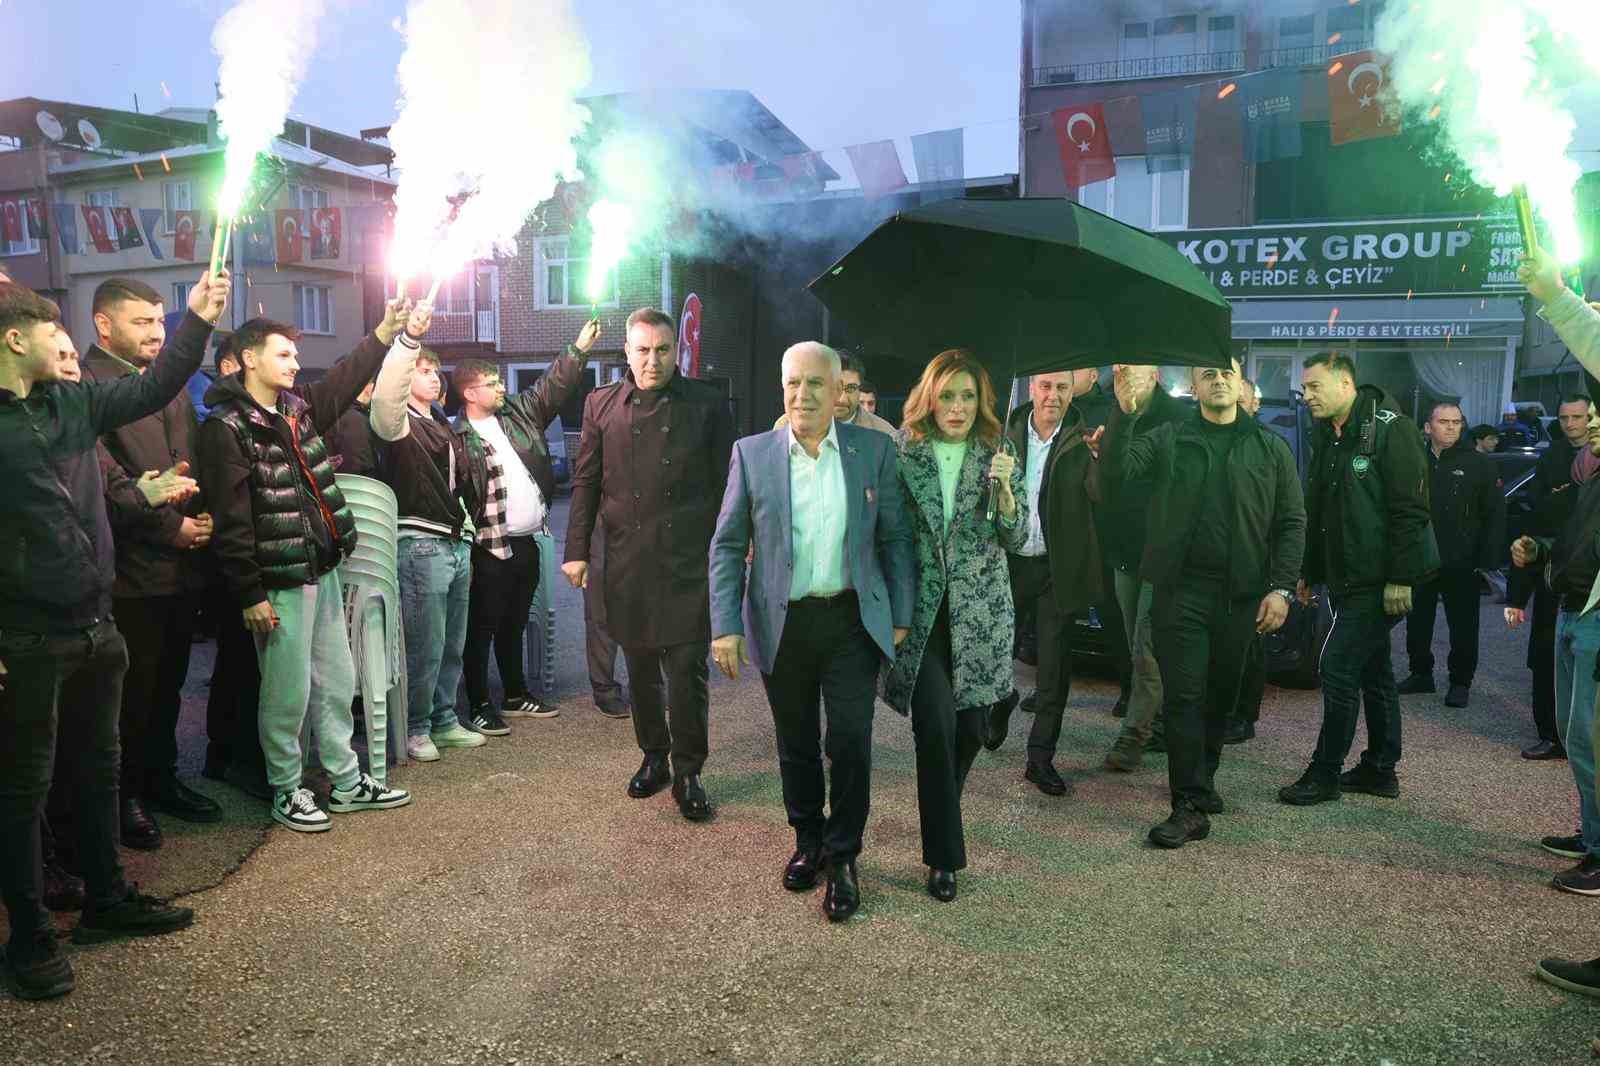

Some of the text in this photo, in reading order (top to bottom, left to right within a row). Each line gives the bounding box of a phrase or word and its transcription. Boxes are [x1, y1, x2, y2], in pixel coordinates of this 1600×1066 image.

[1177, 231, 1472, 265] KOTEX GROUP
[1220, 270, 1234, 287] &
[1240, 269, 1299, 286] PERDE
[1305, 268, 1319, 285] &
[1271, 325, 1304, 337] HALI
[1306, 325, 1316, 337] &
[1319, 325, 1365, 337] PERDE
[1368, 325, 1377, 337] &
[1381, 325, 1400, 336] EV
